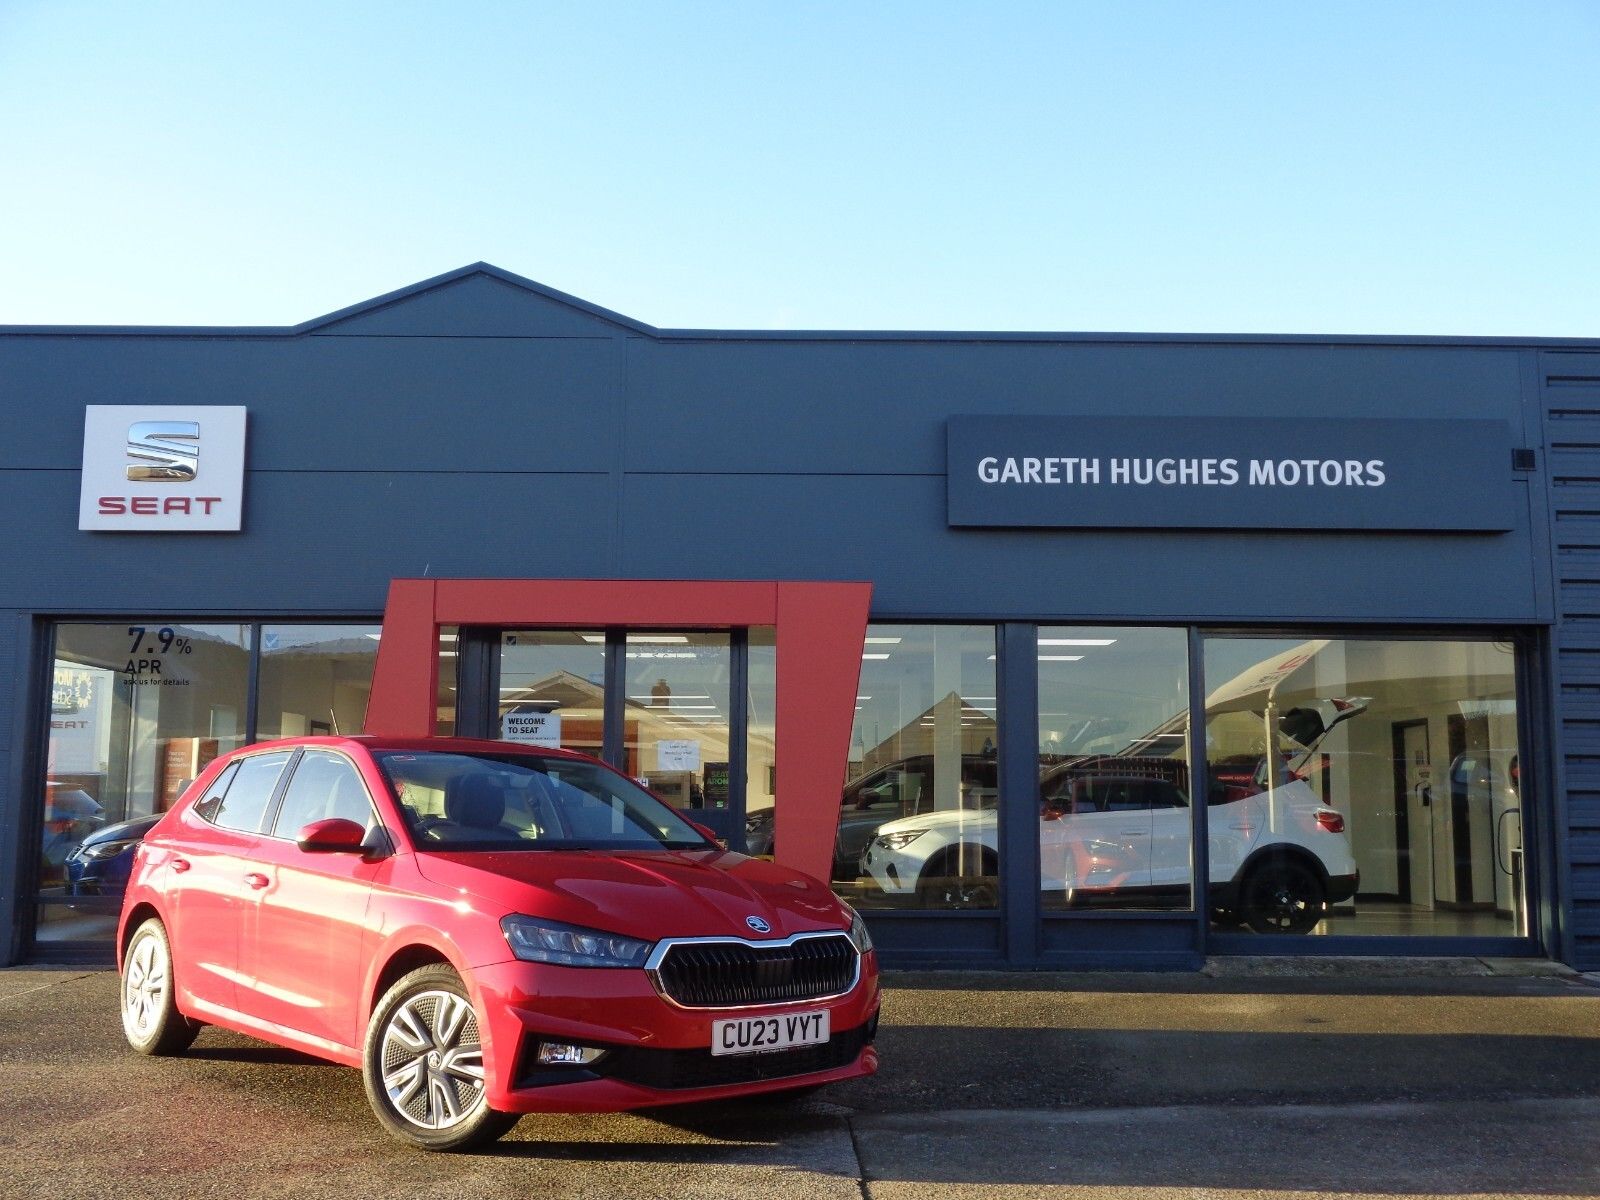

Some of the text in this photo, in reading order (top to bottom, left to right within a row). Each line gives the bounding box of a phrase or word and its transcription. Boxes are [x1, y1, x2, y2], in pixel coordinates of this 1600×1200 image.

[978, 457, 1386, 486] GARETH HUGHES MOTORS
[98, 497, 222, 514] SEAT
[125, 659, 161, 674] APR
[51, 720, 88, 729] EAT
[508, 717, 546, 725] WELCOME
[723, 1014, 823, 1048] CU23 VYT
